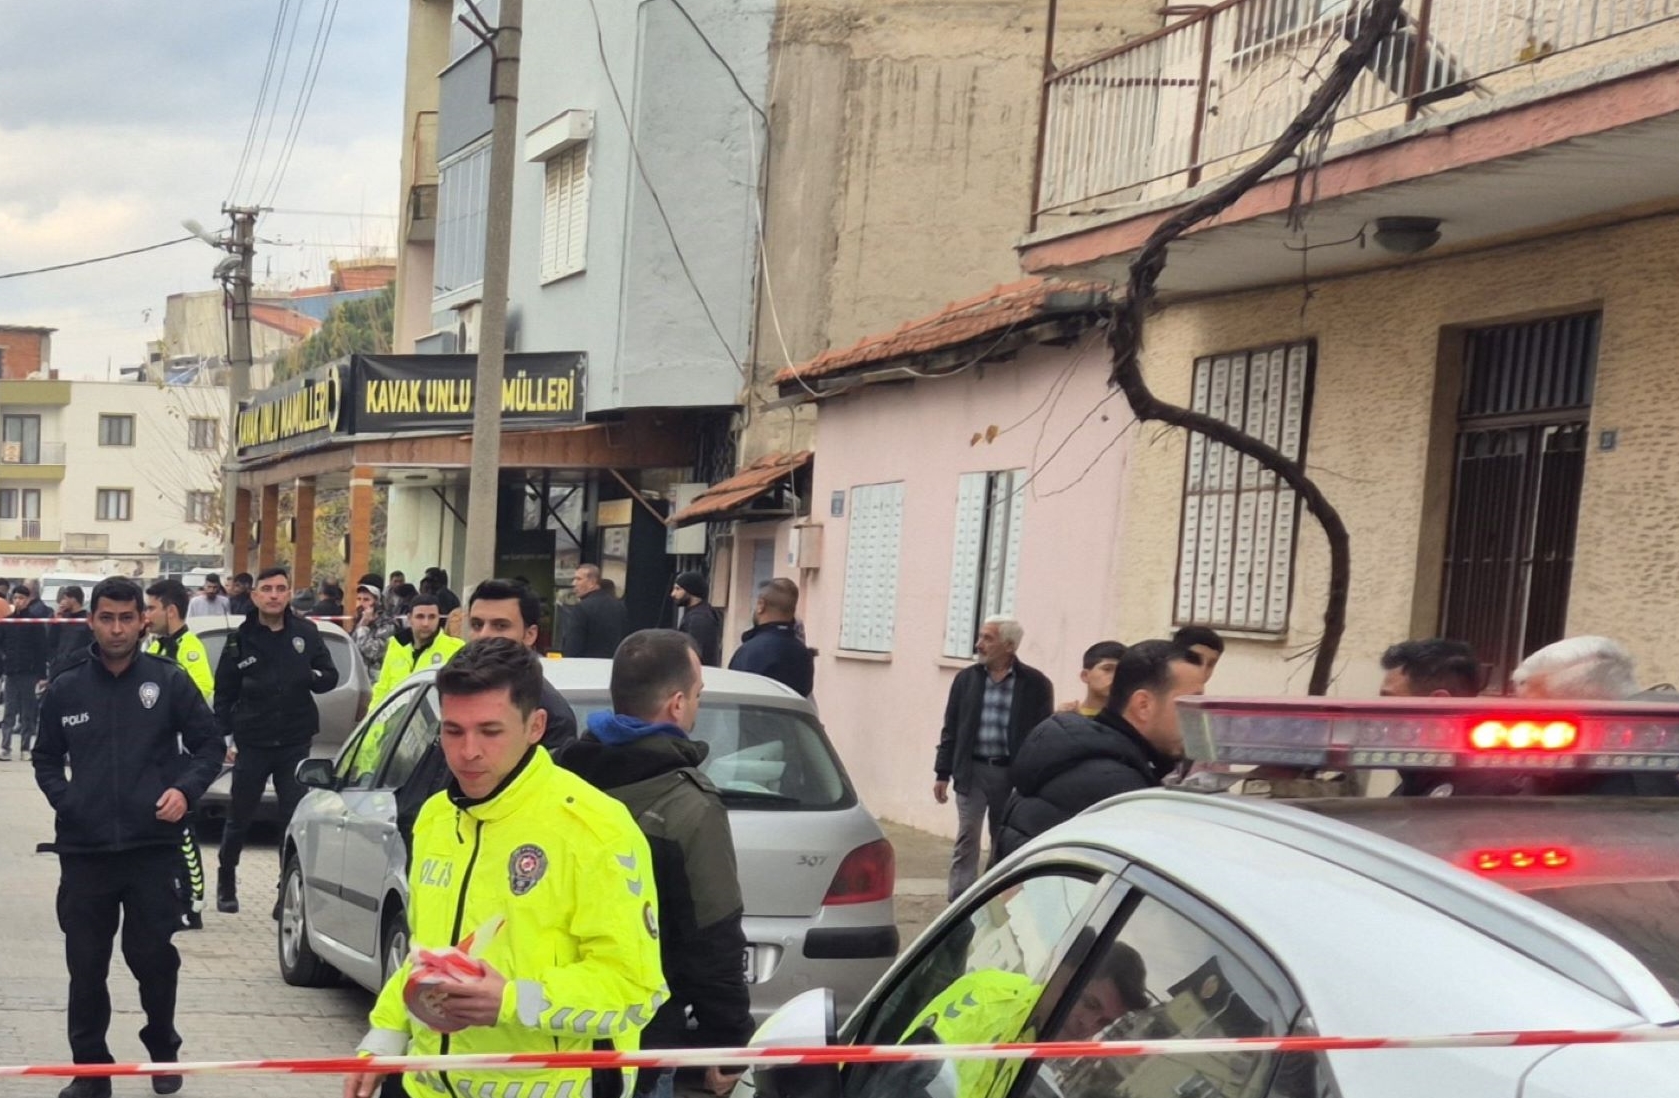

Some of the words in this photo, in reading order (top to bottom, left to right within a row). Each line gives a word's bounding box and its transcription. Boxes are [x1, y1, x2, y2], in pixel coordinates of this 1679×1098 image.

[366, 379, 421, 413] KAVAK
[425, 378, 471, 412] UNLU
[501, 370, 574, 412] MÜLLERİ
[796, 855, 828, 867] 307
